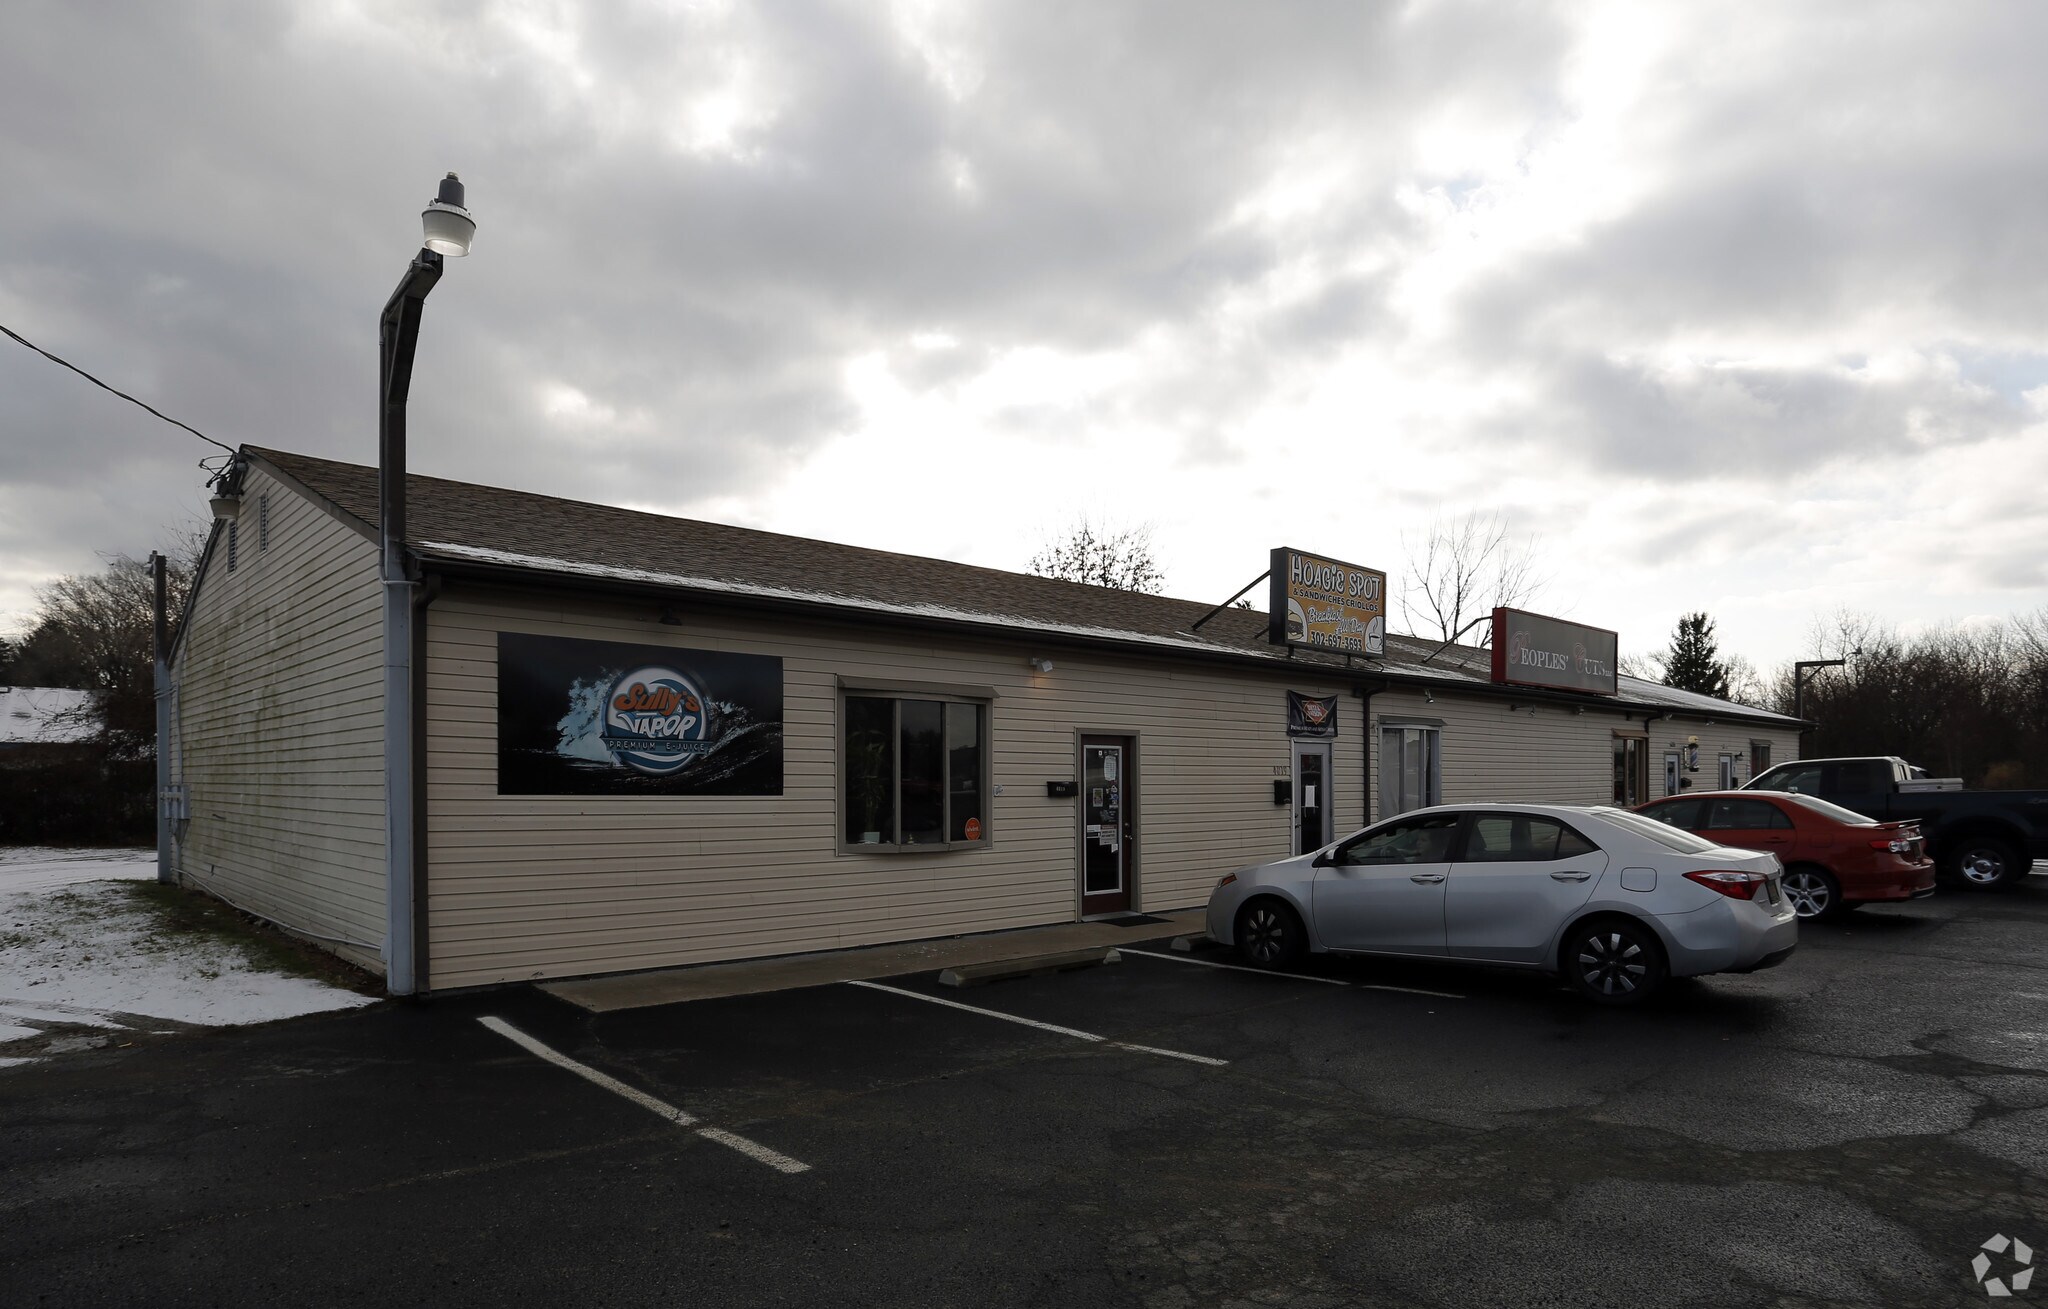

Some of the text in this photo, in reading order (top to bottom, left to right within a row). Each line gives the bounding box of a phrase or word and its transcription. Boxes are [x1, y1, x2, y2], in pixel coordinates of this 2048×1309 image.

[1349, 572, 1380, 600] SPOT
[1293, 588, 1378, 611] & SANDWICHES CRIOLLOS
[1308, 606, 1344, 624] Breakfast
[1335, 617, 1365, 635] All Day
[1311, 632, 1362, 650] 302-697-3693
[614, 682, 700, 716] Sully's
[617, 712, 697, 739] VAPOR
[609, 740, 706, 751] PREMIUM E-JUICE
